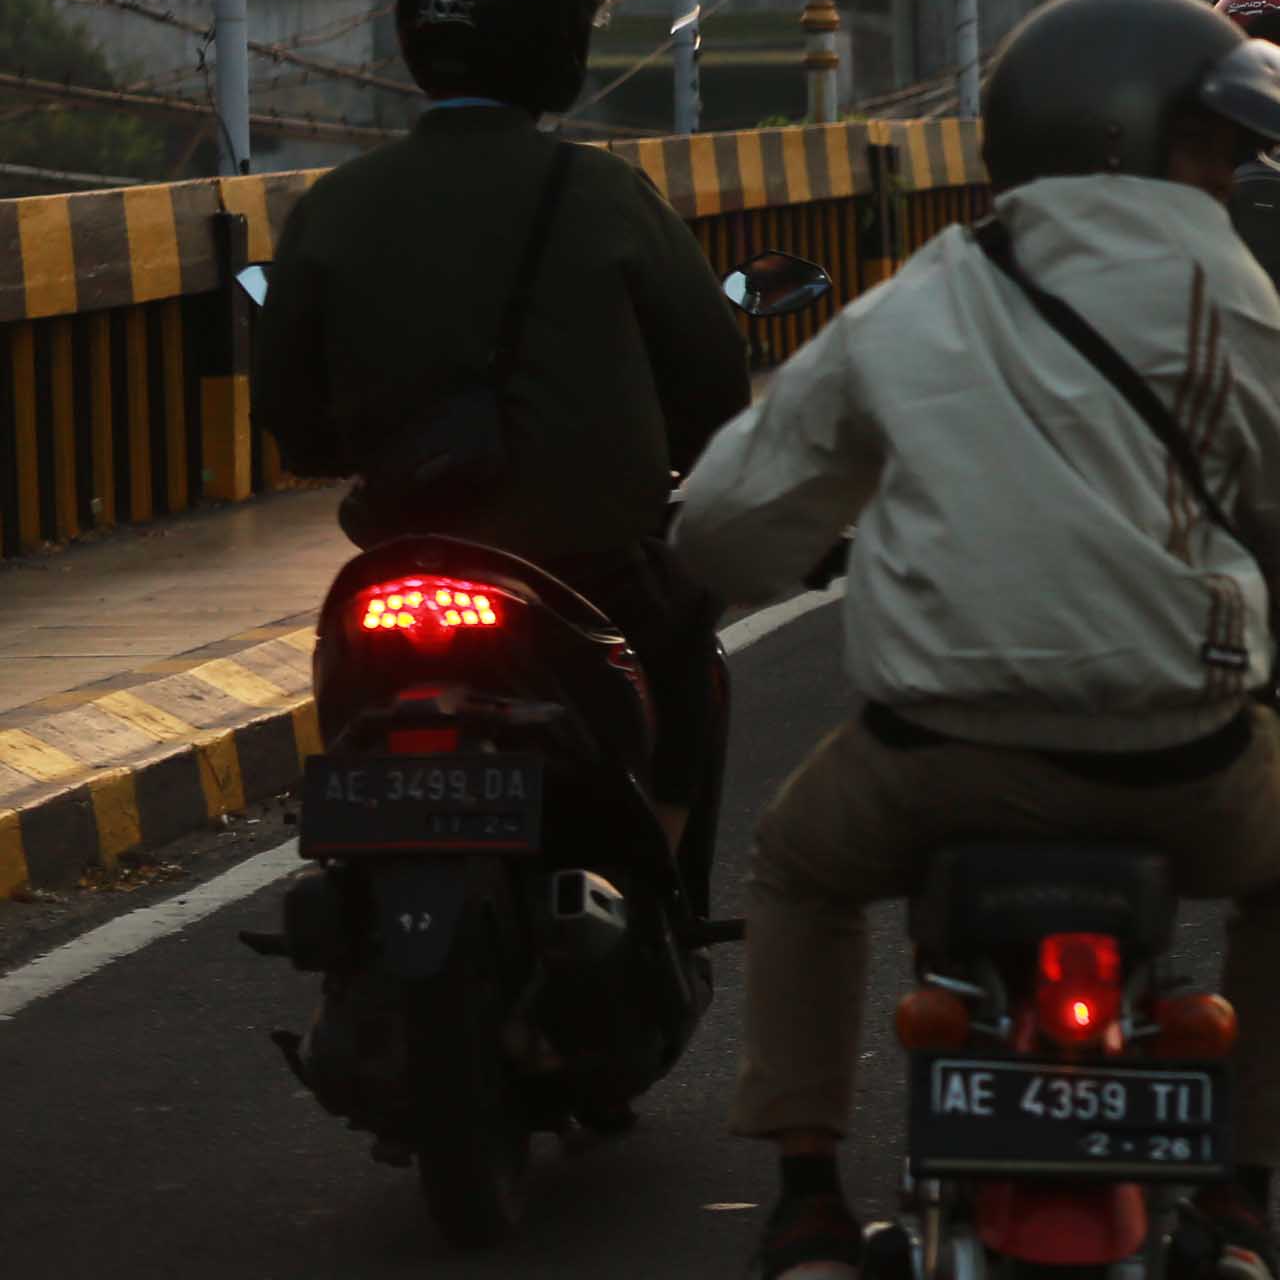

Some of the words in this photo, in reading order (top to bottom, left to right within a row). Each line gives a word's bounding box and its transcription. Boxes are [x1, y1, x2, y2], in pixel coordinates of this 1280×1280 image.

[325, 770, 367, 802] AE
[943, 1073, 995, 1116] AE
[1019, 1077, 1127, 1120] 4359
